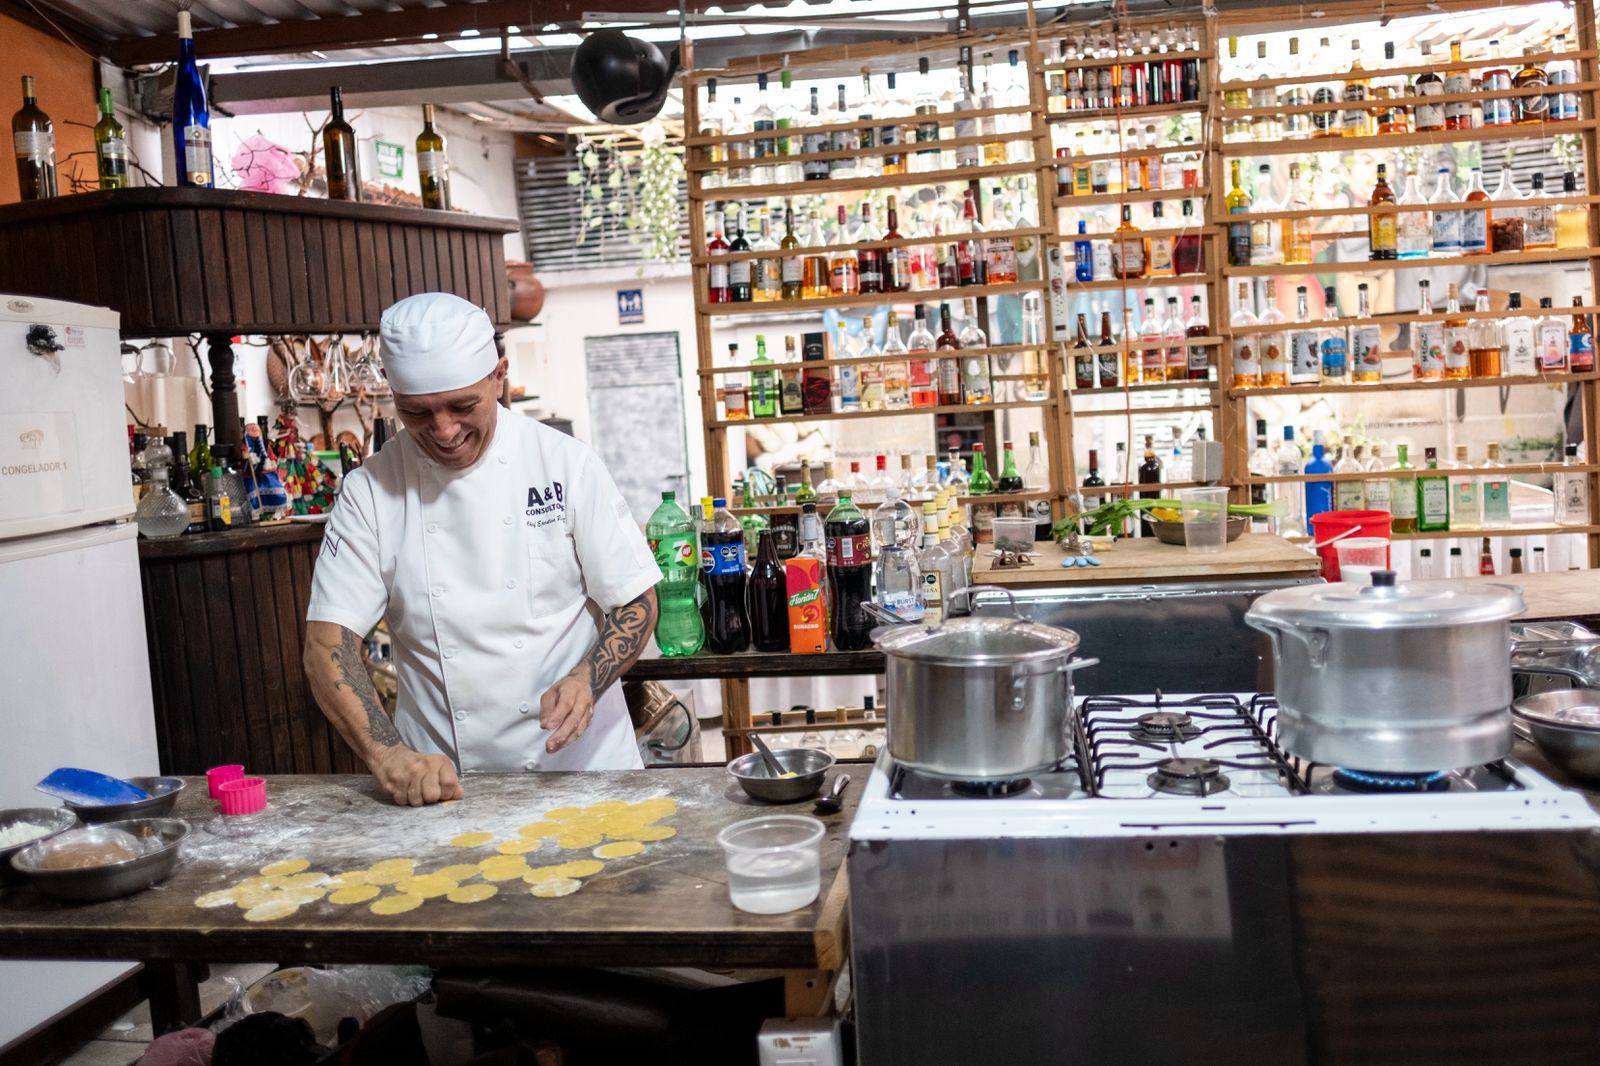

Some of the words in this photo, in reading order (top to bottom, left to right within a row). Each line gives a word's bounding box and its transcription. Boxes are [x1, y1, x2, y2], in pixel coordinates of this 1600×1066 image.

[1, 462, 62, 476] CONGELADOR
[63, 462, 67, 470] 1
[527, 486, 545, 507] A
[544, 486, 554, 501] &
[552, 481, 563, 502] B
[673, 540, 689, 564] 7
